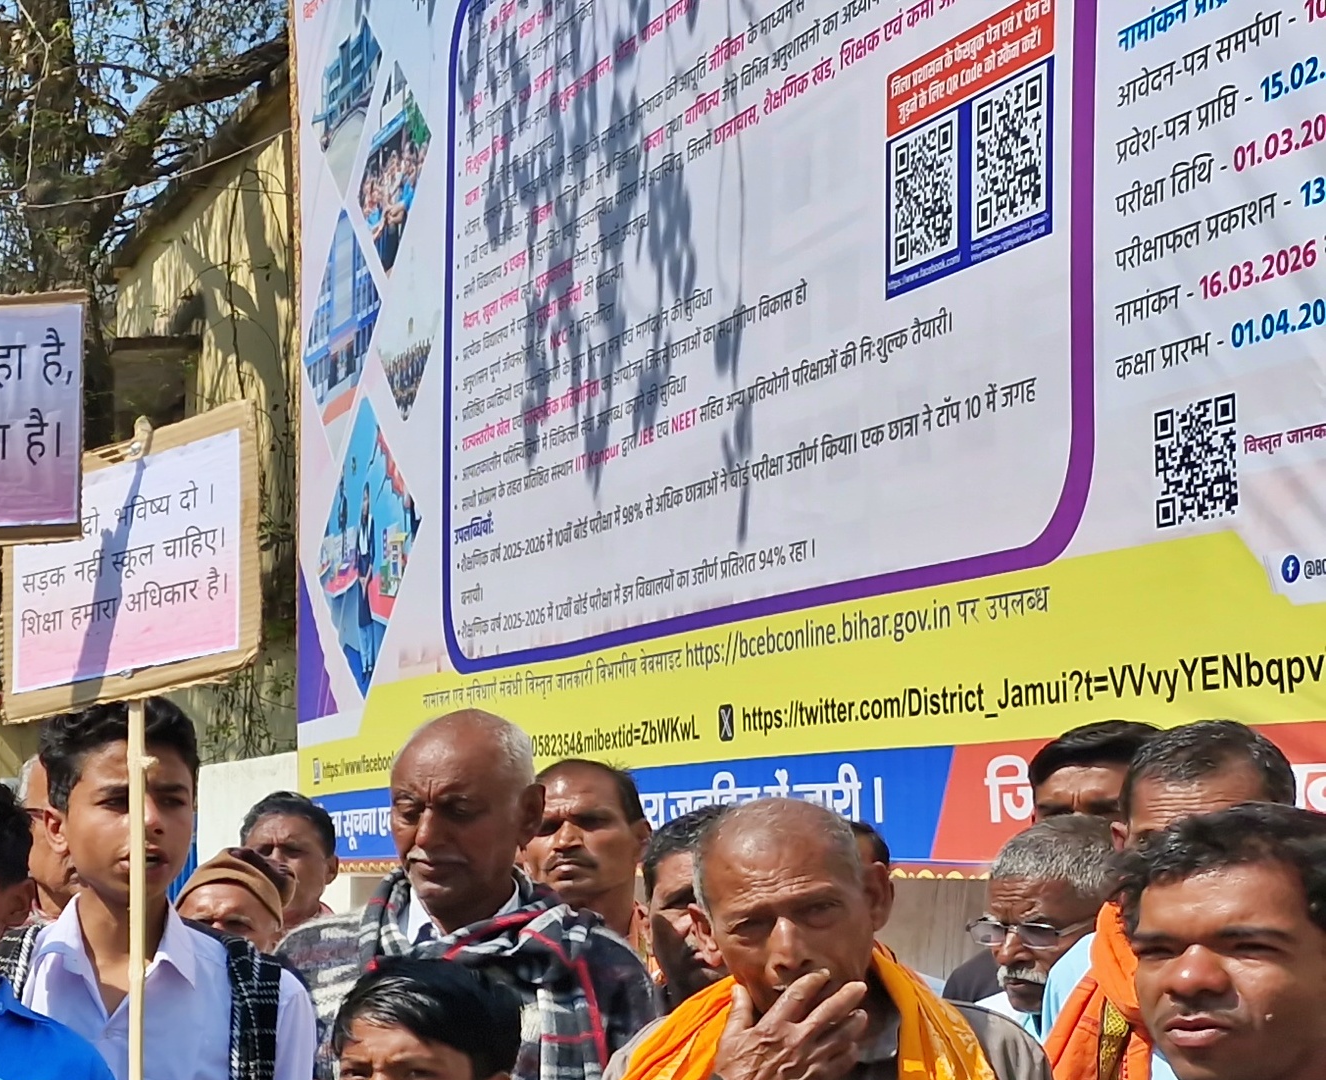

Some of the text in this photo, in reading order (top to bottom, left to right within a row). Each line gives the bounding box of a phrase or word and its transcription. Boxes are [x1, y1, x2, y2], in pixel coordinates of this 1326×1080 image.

[1117, 11, 1282, 107] आवेदन-पत्र समर्पण
[1116, 110, 1192, 164] प्रवेश-पत्र
[1196, 85, 1239, 130] प्राप्ति
[1115, 153, 1214, 216] परीक्षा तिथि
[1115, 193, 1277, 271] परीक्षाफल प्रकाशन
[1115, 240, 1317, 326] नामांकन 16.03.2026
[1115, 332, 1211, 380] कक्षा प्रारम्भ
[24, 409, 61, 465] है।
[671, 408, 697, 434] NEET
[888, 377, 1037, 441] छात्रा टॉप 10 जगह
[114, 480, 198, 526] भविष्य दो
[23, 525, 225, 596] सड़क नहीं स्कूल चाहिए।
[21, 567, 227, 638] शिक्षा हमारा अधिकार है।
[685, 599, 950, 671] https://bcebconline.bihar.gov.in
[985, 586, 1050, 622] उपलब्ध
[742, 646, 1326, 735] https://twitter.com/District_Jamui?t=VVvyYENbqpv
